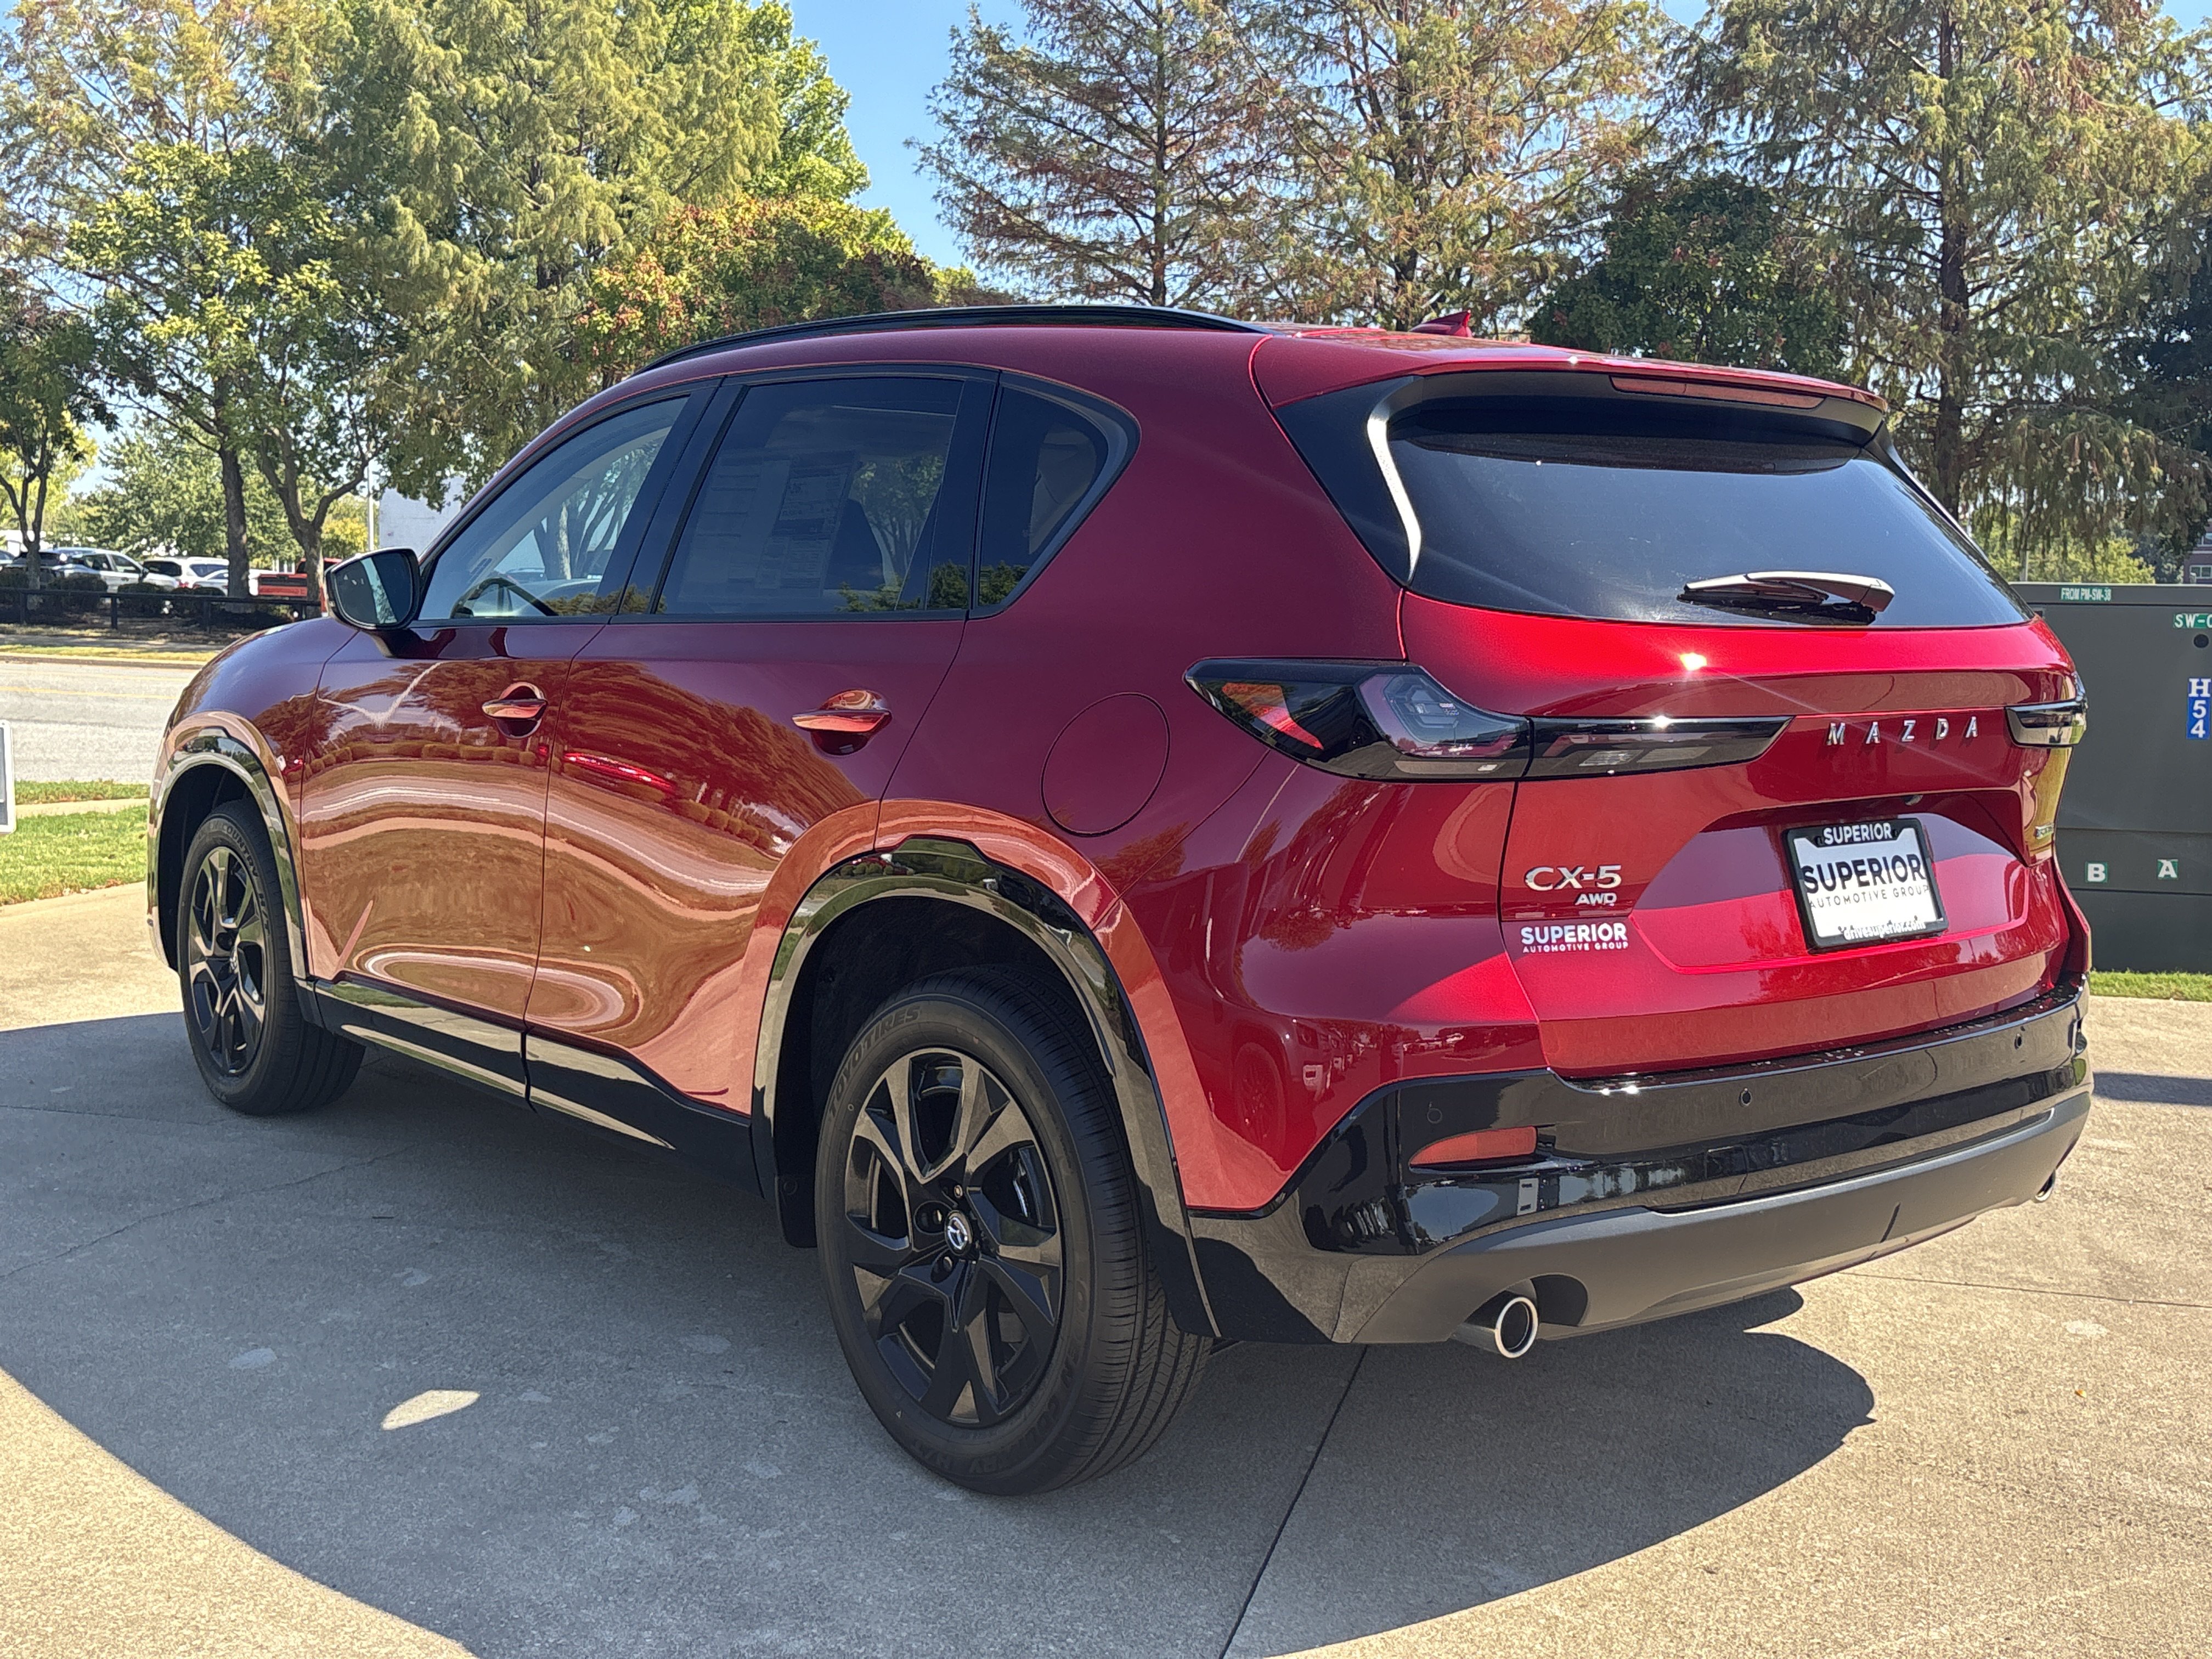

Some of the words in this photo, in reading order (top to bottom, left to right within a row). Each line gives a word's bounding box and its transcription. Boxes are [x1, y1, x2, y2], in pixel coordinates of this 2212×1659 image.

[2061, 587, 2079, 600] FROM
[1827, 716, 1979, 746] MAZDA
[1822, 822, 1893, 845] SUPERIOR
[1525, 865, 1622, 891] CX-5
[1801, 854, 1927, 894] SUPERIOR
[2087, 863, 2106, 882] B
[2158, 859, 2178, 878] A
[1574, 892, 1617, 906] AWD
[1809, 889, 1888, 909] AUTOMOTIVE
[1893, 884, 1930, 898] GROUP
[1520, 923, 1628, 945] SUPERIOR
[1843, 919, 1927, 941] drivesuperior.com
[1522, 943, 1590, 953] AUTOMOTIVE
[1594, 941, 1629, 950] GROUP
